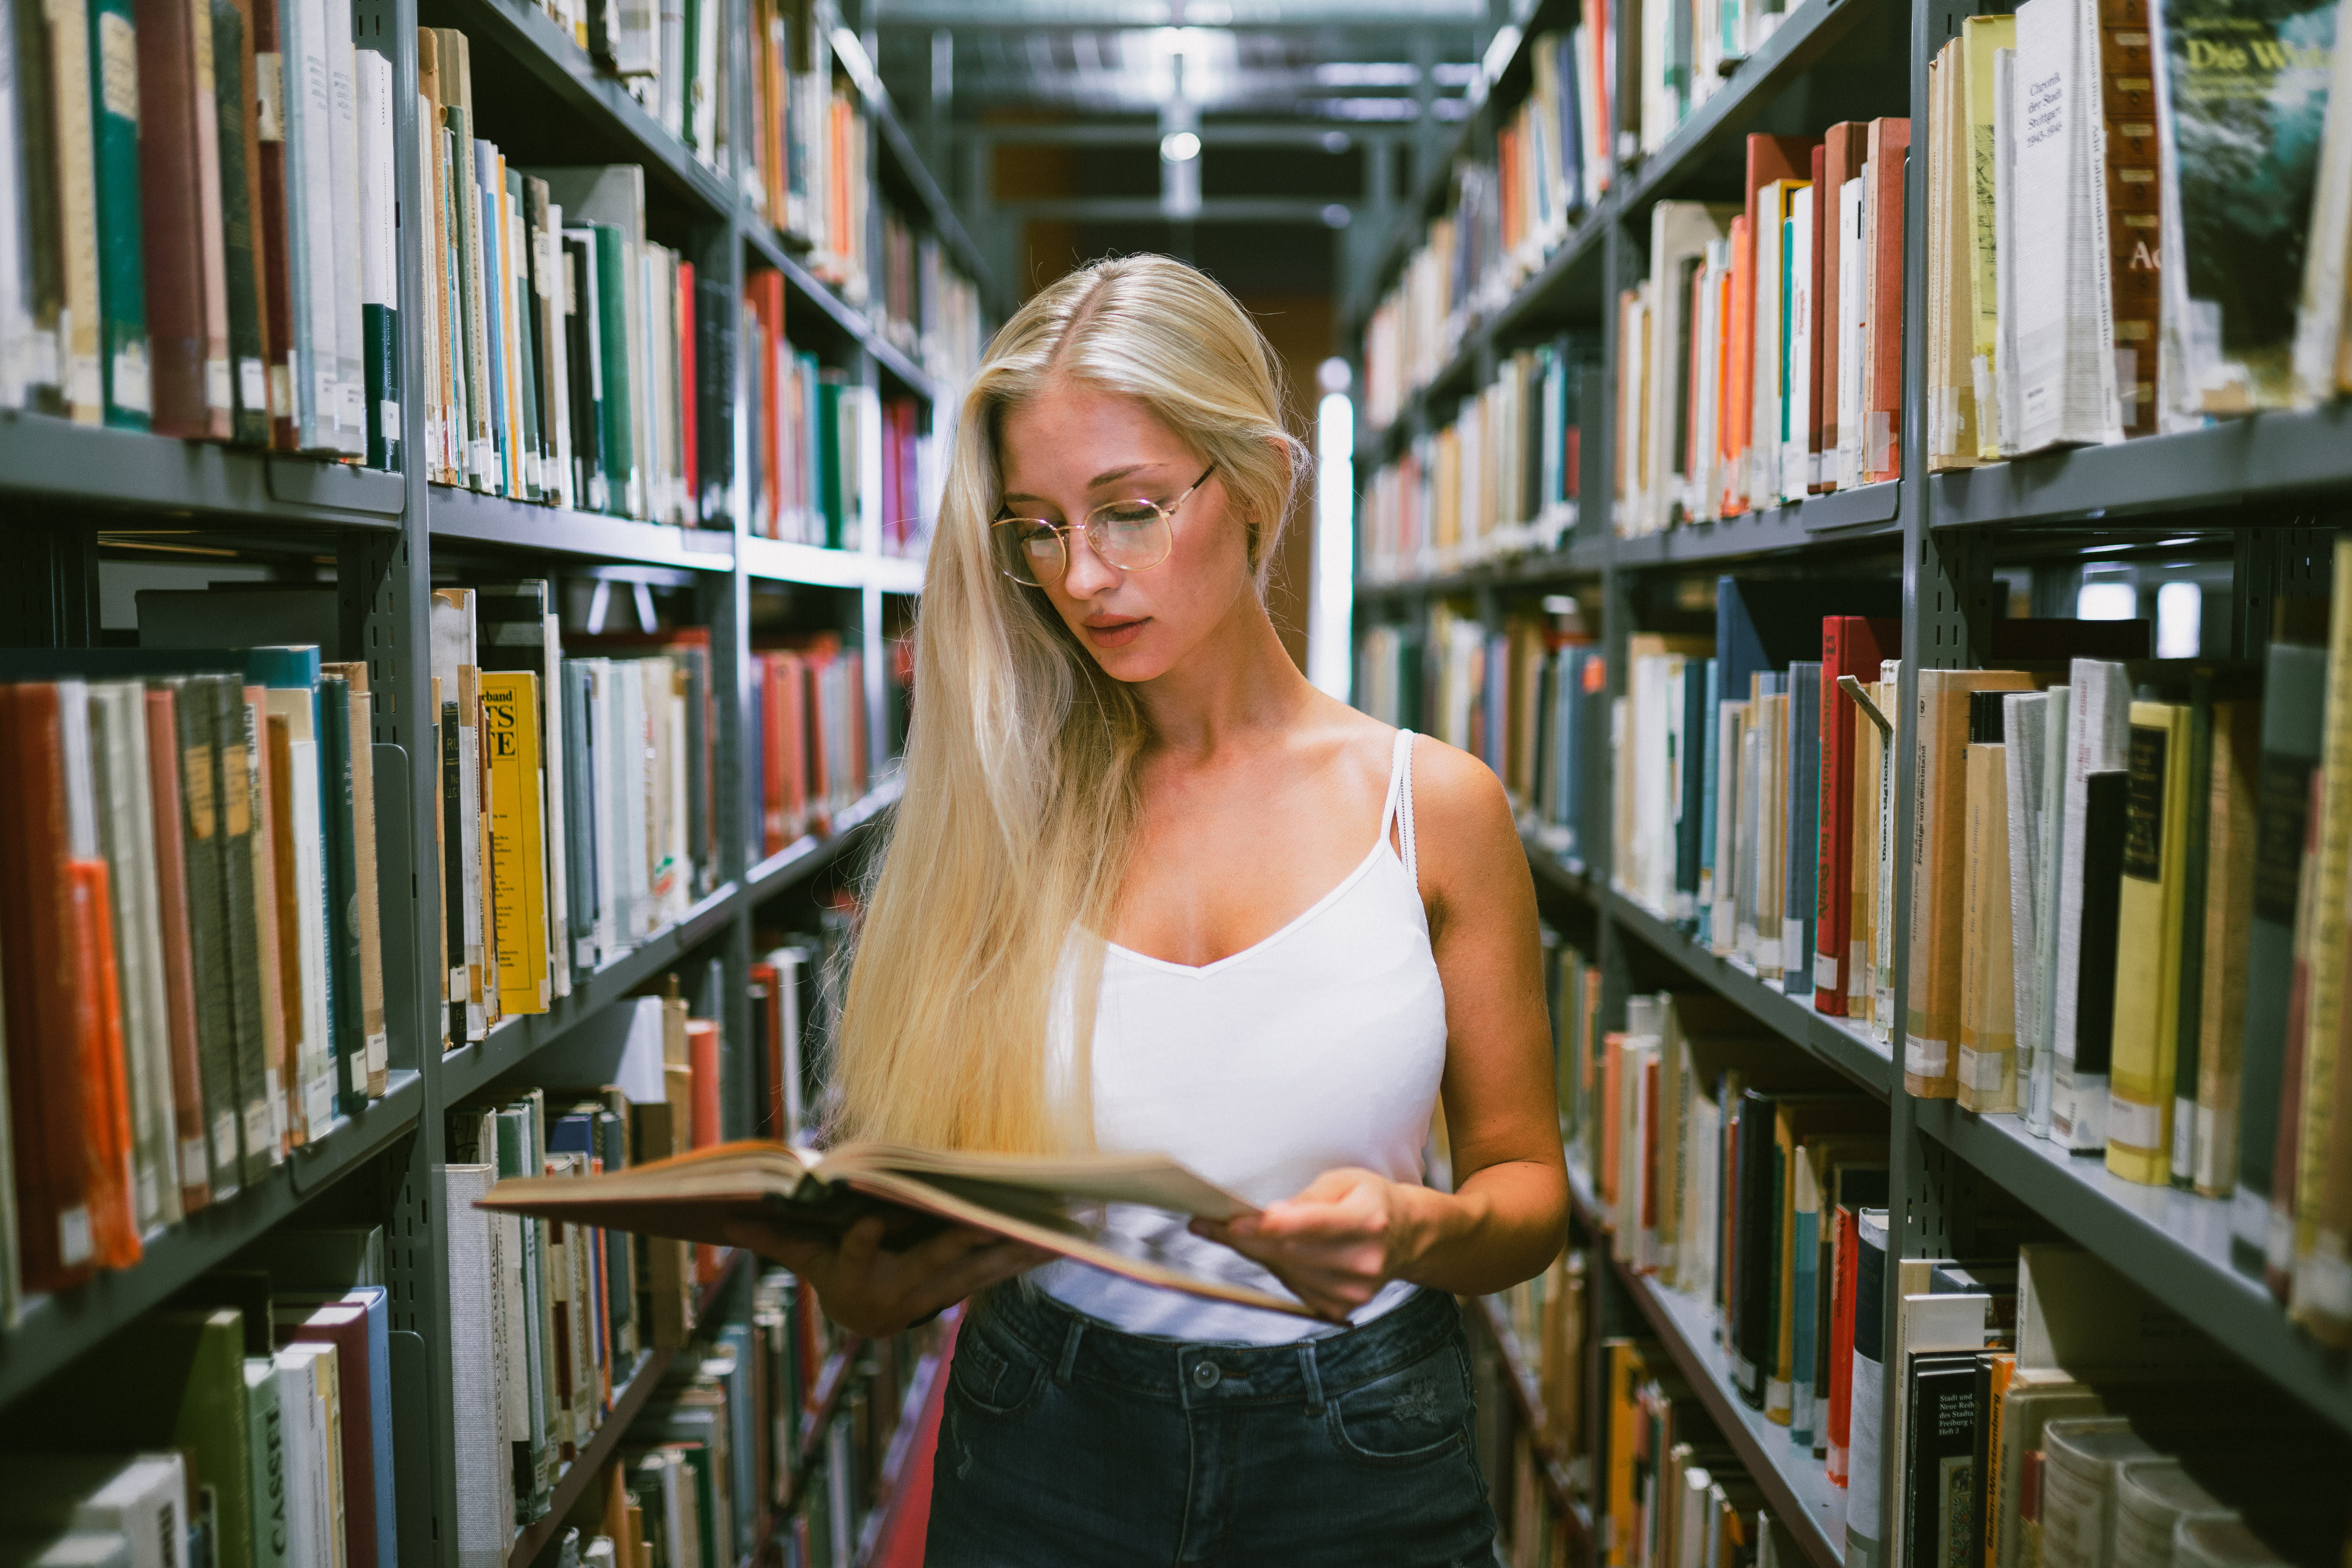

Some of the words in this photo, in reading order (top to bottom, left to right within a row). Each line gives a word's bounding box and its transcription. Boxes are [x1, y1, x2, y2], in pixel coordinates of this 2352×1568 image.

[2186, 38, 2249, 69] Die
[2030, 72, 2061, 96] Chronik
[2043, 88, 2062, 104] Stadt
[2028, 106, 2062, 130] Stuttgart
[2092, 125, 2102, 152] Acht
[2094, 158, 2105, 244] Jahrhunderte
[2099, 249, 2110, 350] Stadtgeschichte
[1987, 1393, 2001, 1549] Baden-Württemberg
